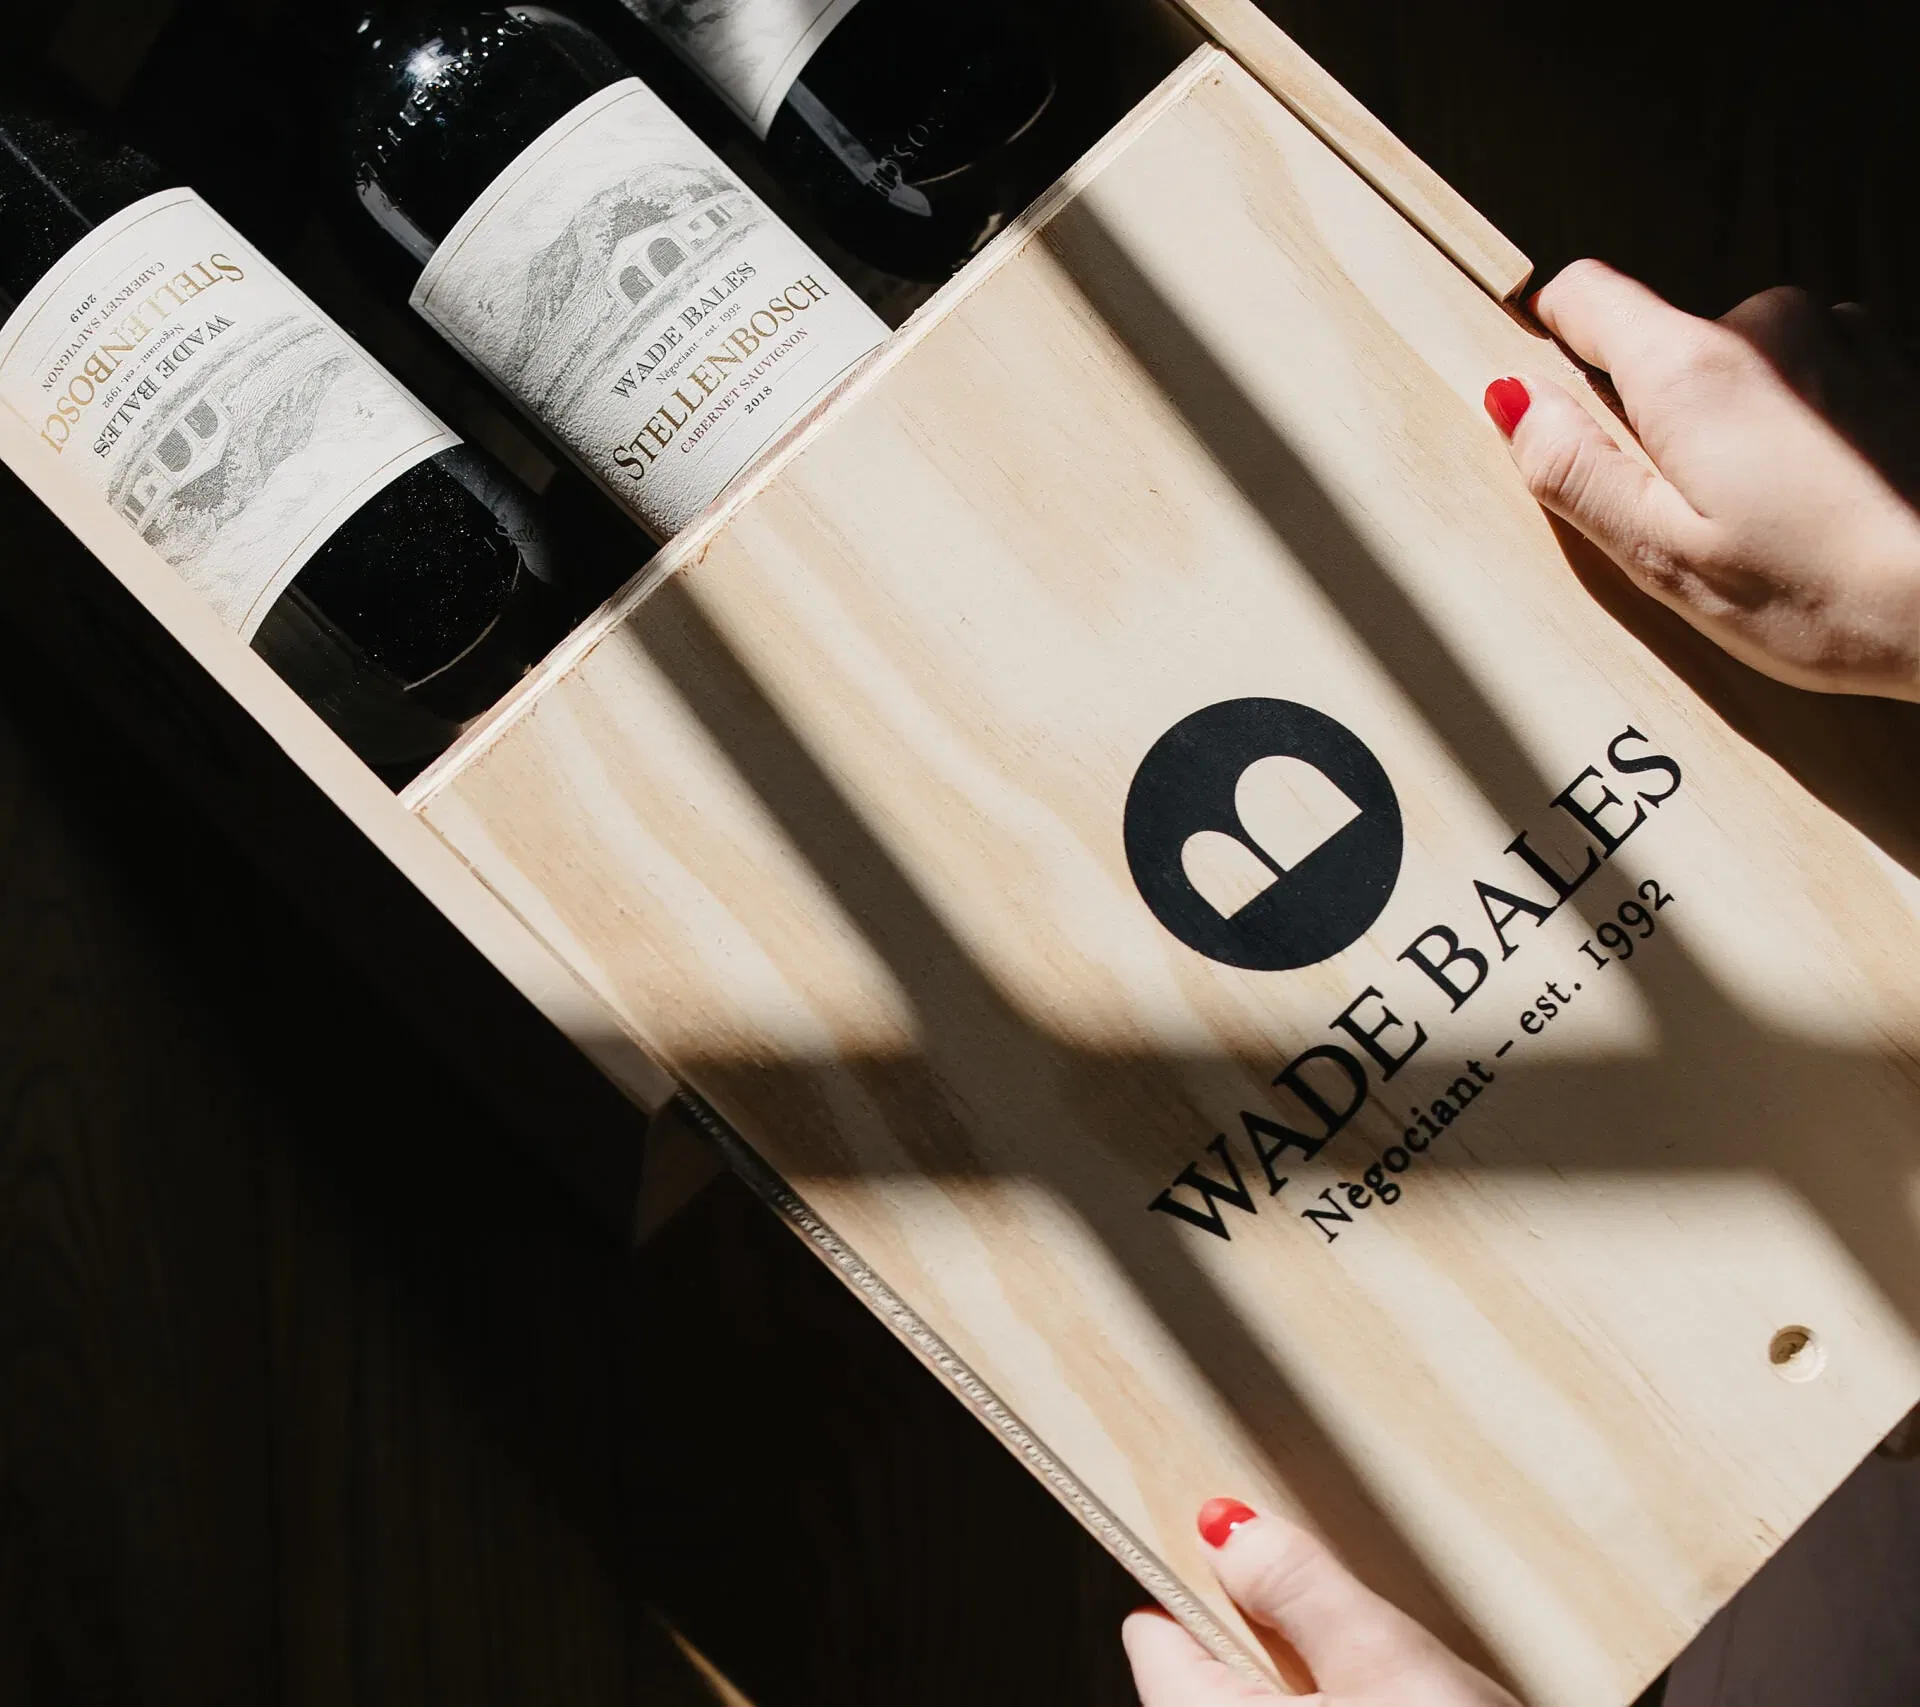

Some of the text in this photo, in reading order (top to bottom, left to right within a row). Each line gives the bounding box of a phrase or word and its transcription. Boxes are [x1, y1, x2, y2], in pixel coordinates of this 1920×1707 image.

[41, 261, 165, 393] CABERNET SAUVIGNON
[70, 293, 97, 323] 2019
[610, 261, 757, 399] WADE BALES
[720, 303, 741, 323] 1992
[93, 314, 236, 458] WADE BALES
[102, 386, 123, 410] 1992
[612, 274, 830, 481] STELLENBOSCH
[680, 327, 808, 454] CABERNET SAUVIGNON
[744, 385, 773, 414] 2018
[1147, 724, 1682, 1242] WADE BALES
[1519, 982, 1582, 1036] est.
[1578, 879, 1676, 970] 1992
